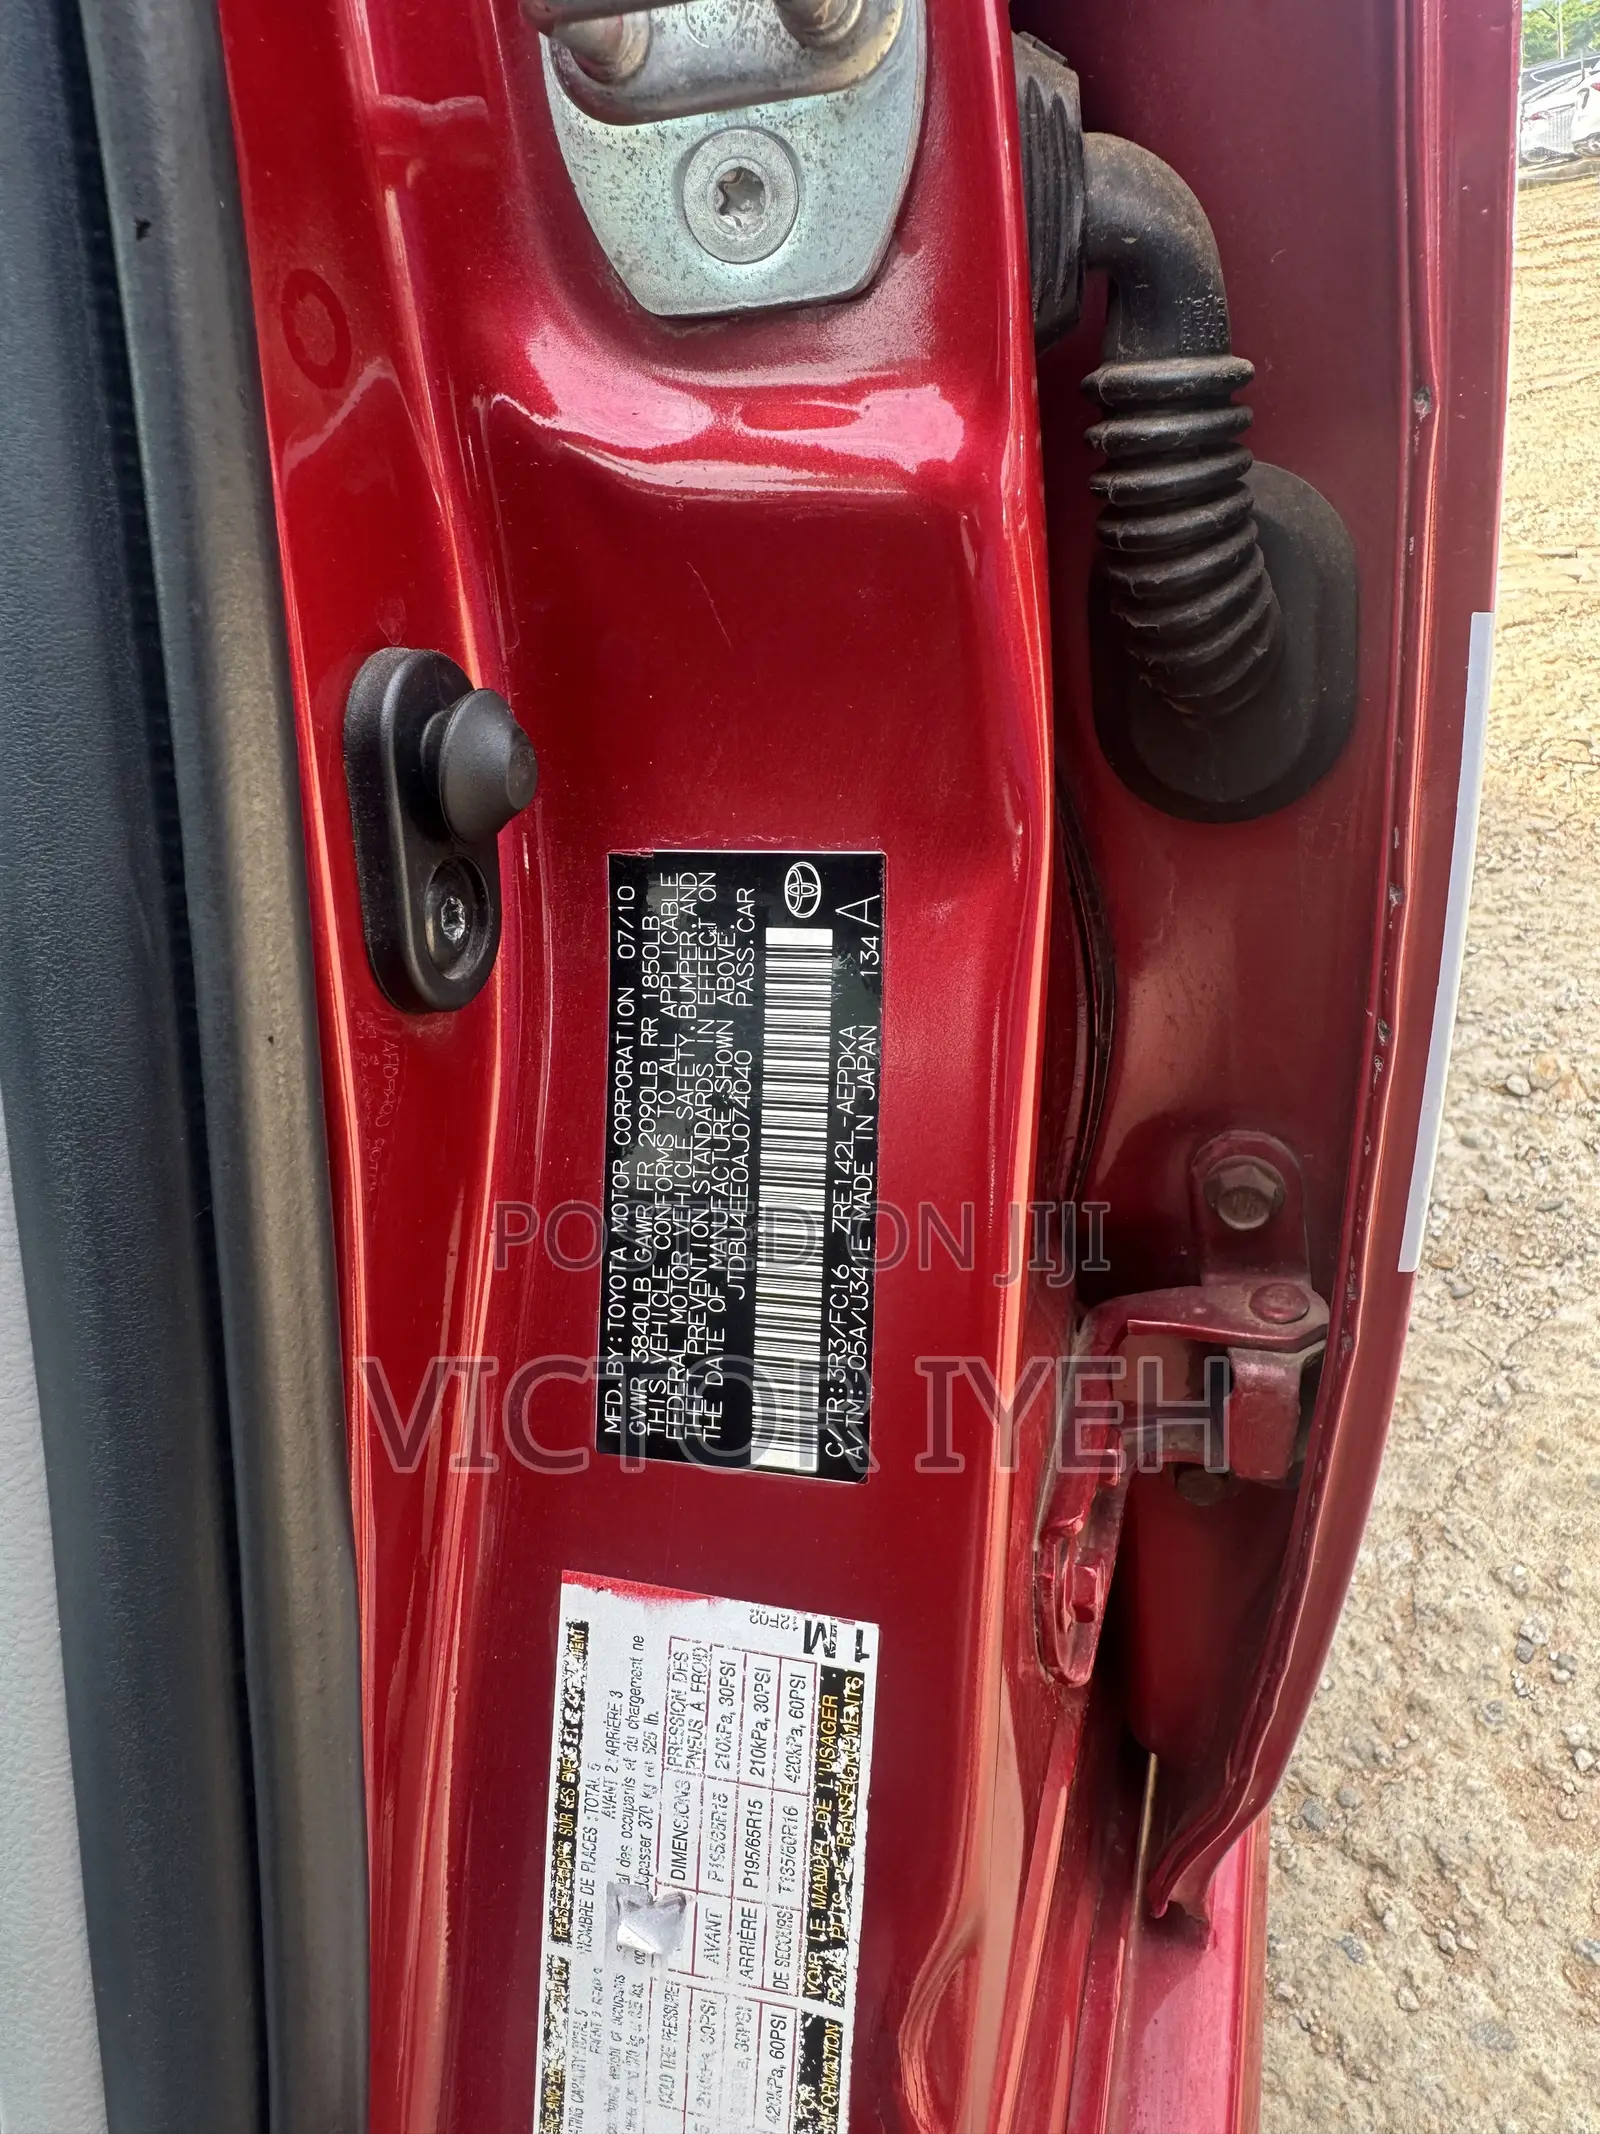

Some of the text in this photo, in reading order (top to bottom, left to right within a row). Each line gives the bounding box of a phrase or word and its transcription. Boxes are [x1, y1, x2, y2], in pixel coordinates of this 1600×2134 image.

[617, 886, 635, 959] 07/10
[835, 895, 880, 976] 134 A
[614, 987, 635, 1146] CORPORATION
[717, 1020, 734, 1093] SHOWN
[858, 1025, 877, 1100] JAPAN
[648, 872, 679, 1435] THIS VEHICLE CONFORMS TO ALL APPLICABLE
[685, 872, 717, 1439] THEFT PREVENTION STANDARDS IN EFFECT ON
[832, 1026, 857, 1234] ZRE142L-AEPDKA
[856, 1115, 874, 1139] IN
[611, 1159, 630, 1233] MOTOR
[629, 916, 660, 1435] GVWR 3840LB GAWR FR 2090LB RR 1850LB
[673, 1135, 693, 1236] VEHICLE
[710, 1108, 732, 1270] MANUFACTURE
[853, 1161, 873, 1220] MADE
[671, 1251, 689, 1324] MOTOR
[708, 1283, 726, 1312] OF
[668, 1339, 686, 1441] FEDERAL
[705, 1328, 725, 1386] DATE
[703, 1402, 722, 1442] THE
[632, 1636, 643, 1651] ne
[626, 1657, 643, 1730] chargement
[754, 1668, 771, 1713] 30PSI
[749, 1719, 770, 1777] 210kPa,
[559, 1813, 574, 1836] SUR
[580, 1826, 597, 1873] PLACES
[638, 1806, 653, 1829] 370
[670, 1780, 690, 1880] DIMENSIONS
[743, 1800, 762, 1888] P195/65R15
[773, 1972, 789, 1989] DE
[788, 1673, 806, 1718] 60PSI
[580, 1877, 595, 1896] DE
[616, 1846, 632, 1867] des
[769, 2013, 787, 2060] 60PSI
